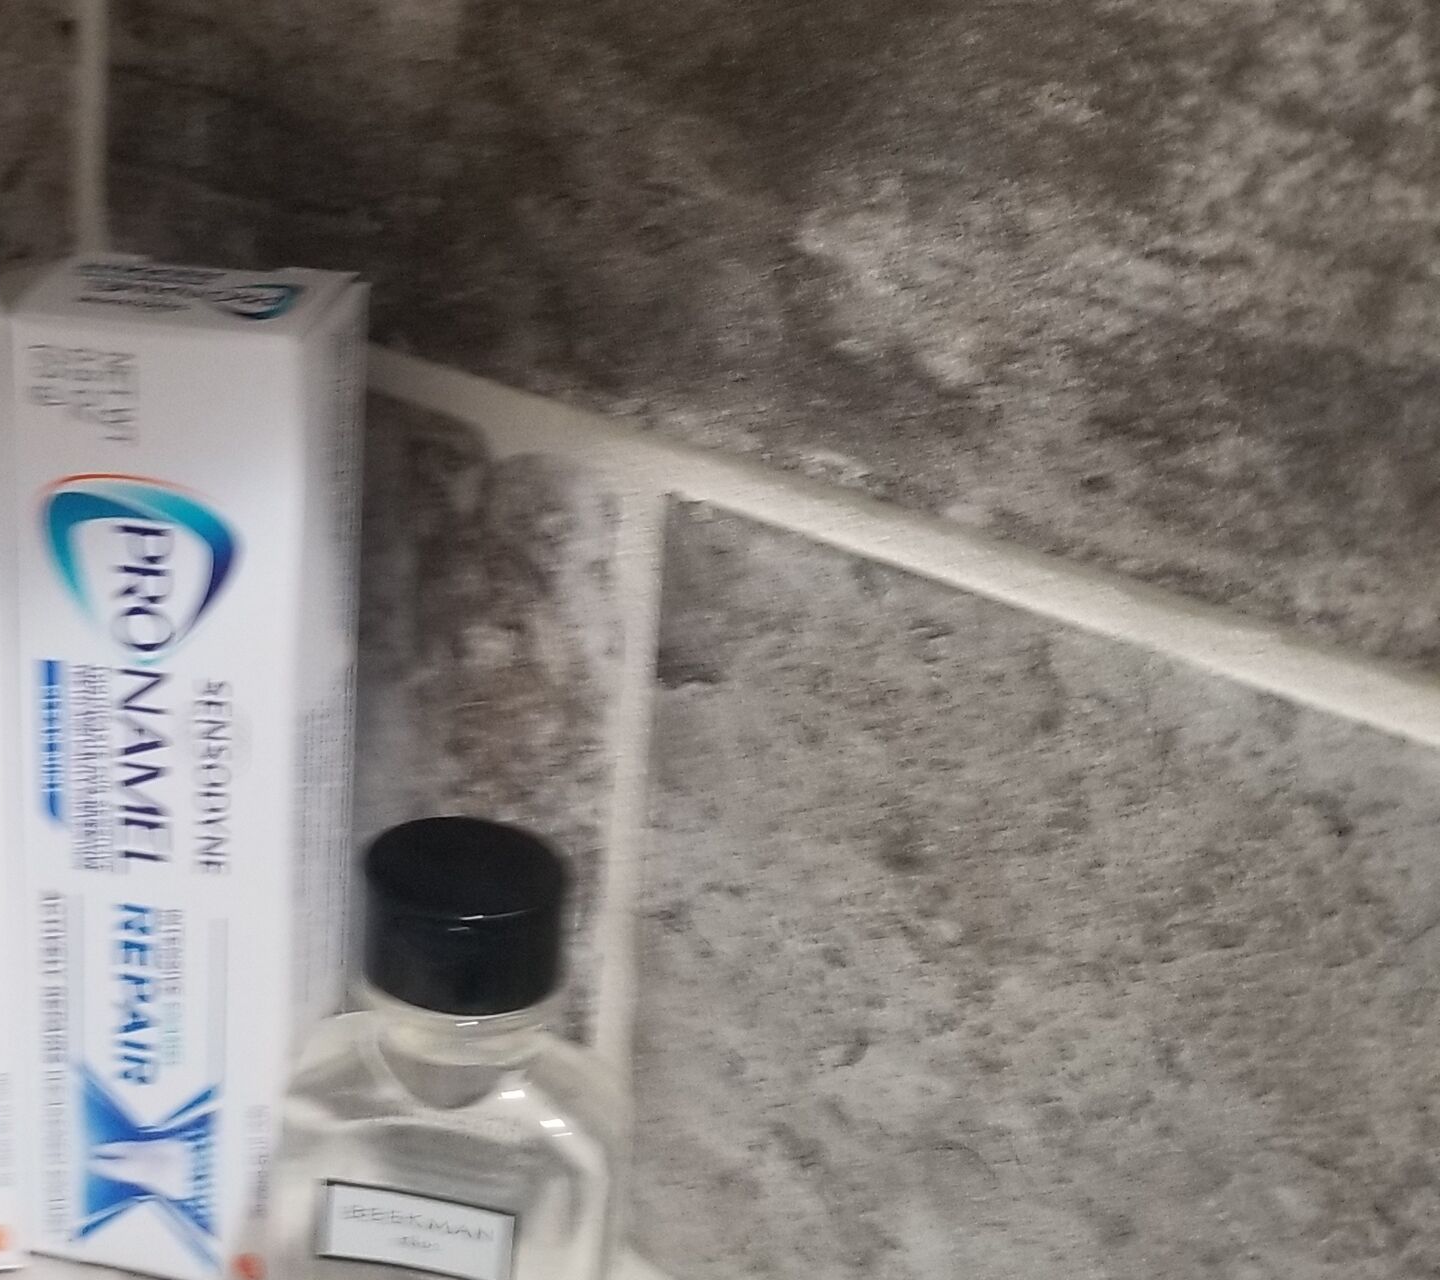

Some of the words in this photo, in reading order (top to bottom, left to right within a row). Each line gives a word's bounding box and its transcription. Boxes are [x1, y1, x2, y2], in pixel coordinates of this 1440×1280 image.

[111, 522, 176, 874] PRONAMEL
[193, 678, 235, 876] SENSODYNE
[113, 904, 160, 1086] REPAIR
